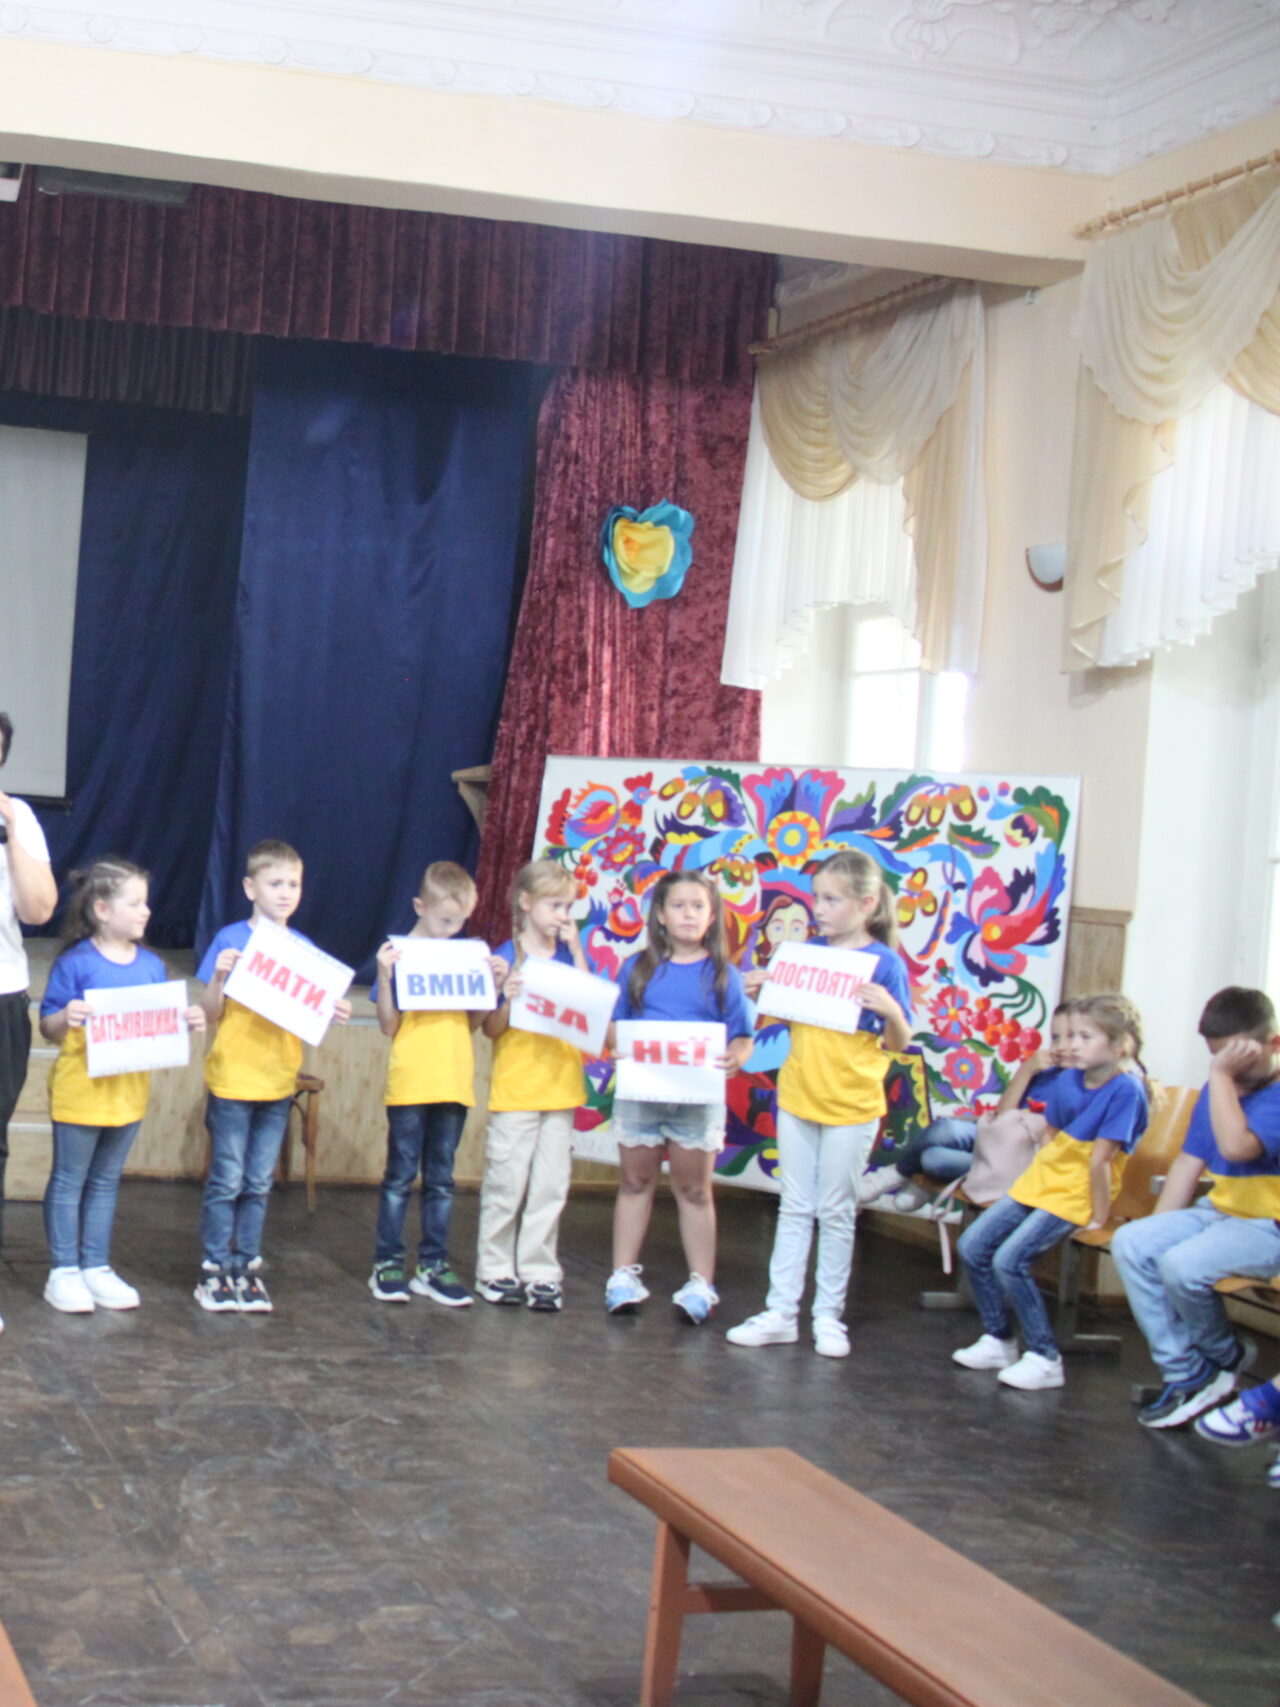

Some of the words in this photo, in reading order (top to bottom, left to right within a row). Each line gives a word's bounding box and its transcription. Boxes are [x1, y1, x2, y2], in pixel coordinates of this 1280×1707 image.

[406, 969, 487, 997] ВМІЙ
[525, 993, 589, 1036] ЗА
[632, 1036, 711, 1067] НЕЇ
